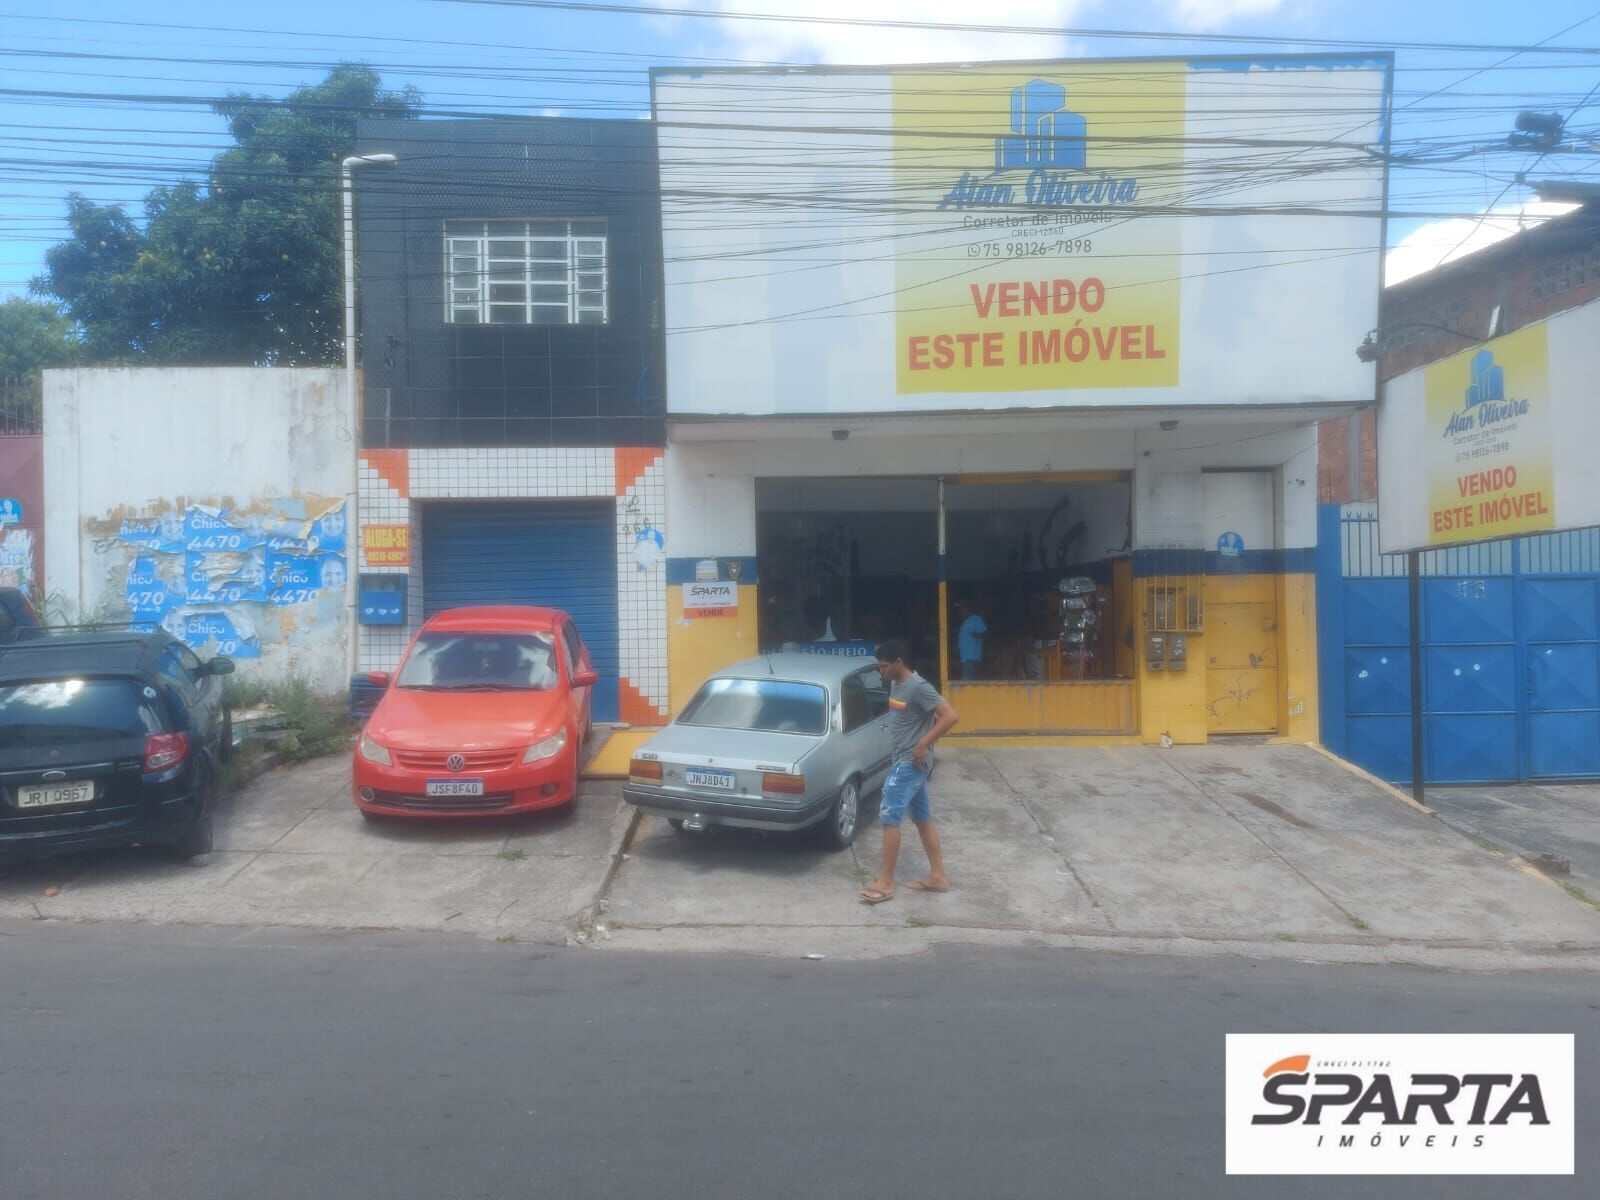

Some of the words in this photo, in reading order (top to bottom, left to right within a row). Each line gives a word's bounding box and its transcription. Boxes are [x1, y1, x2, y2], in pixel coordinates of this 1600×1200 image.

[936, 171, 1015, 210] Alan
[1025, 169, 1139, 209] Oliveira
[963, 215, 1025, 229] Corretor
[1032, 212, 1048, 226] de
[984, 243, 1000, 257] 75
[1006, 240, 1092, 257] 98126-7898
[970, 277, 1105, 318] VENDO
[908, 332, 1005, 371] ESTE
[1019, 318, 1166, 365] IMÓVEL
[1443, 411, 1475, 438] Alan
[1479, 398, 1530, 428] Oliveira
[1457, 464, 1517, 498] VENDO
[1433, 505, 1474, 533] ESTE
[1479, 492, 1548, 525] IMÓVEL
[187, 535, 241, 550] 4470
[690, 585, 730, 596] SPARTA
[698, 608, 725, 617] VENDE
[432, 783, 478, 795] JSF8F40
